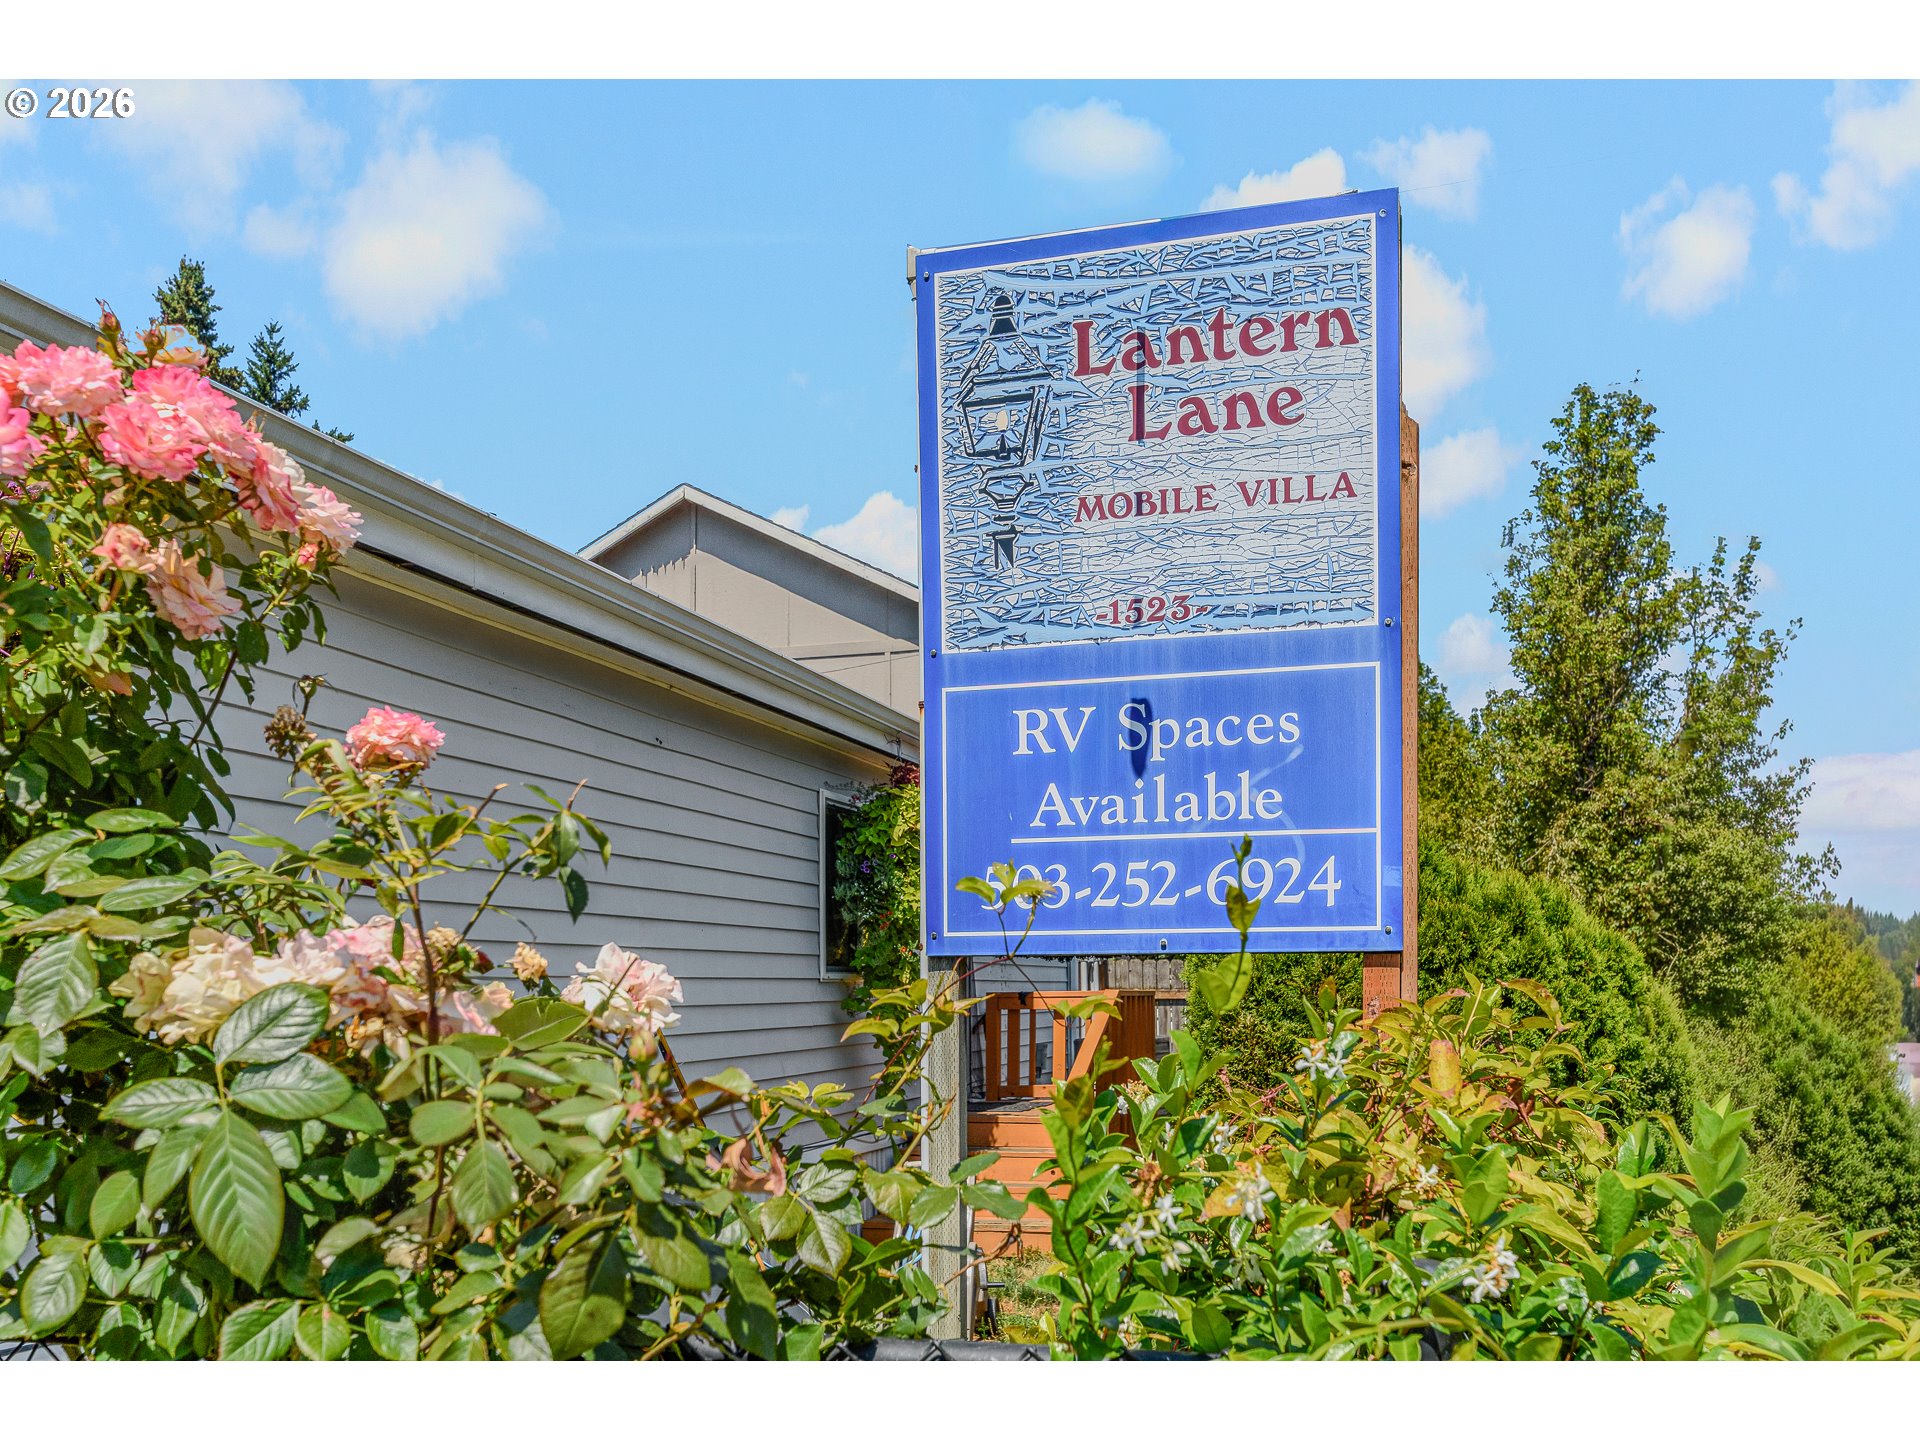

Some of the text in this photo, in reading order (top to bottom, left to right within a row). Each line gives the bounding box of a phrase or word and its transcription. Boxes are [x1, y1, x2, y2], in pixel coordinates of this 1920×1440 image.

[1073, 308, 1360, 377] Lantern
[1127, 386, 1305, 442] Lane
[1074, 472, 1358, 522] MOBILE VILLA
[1012, 703, 1301, 762] RV Spaces
[1030, 769, 1283, 828] Available
